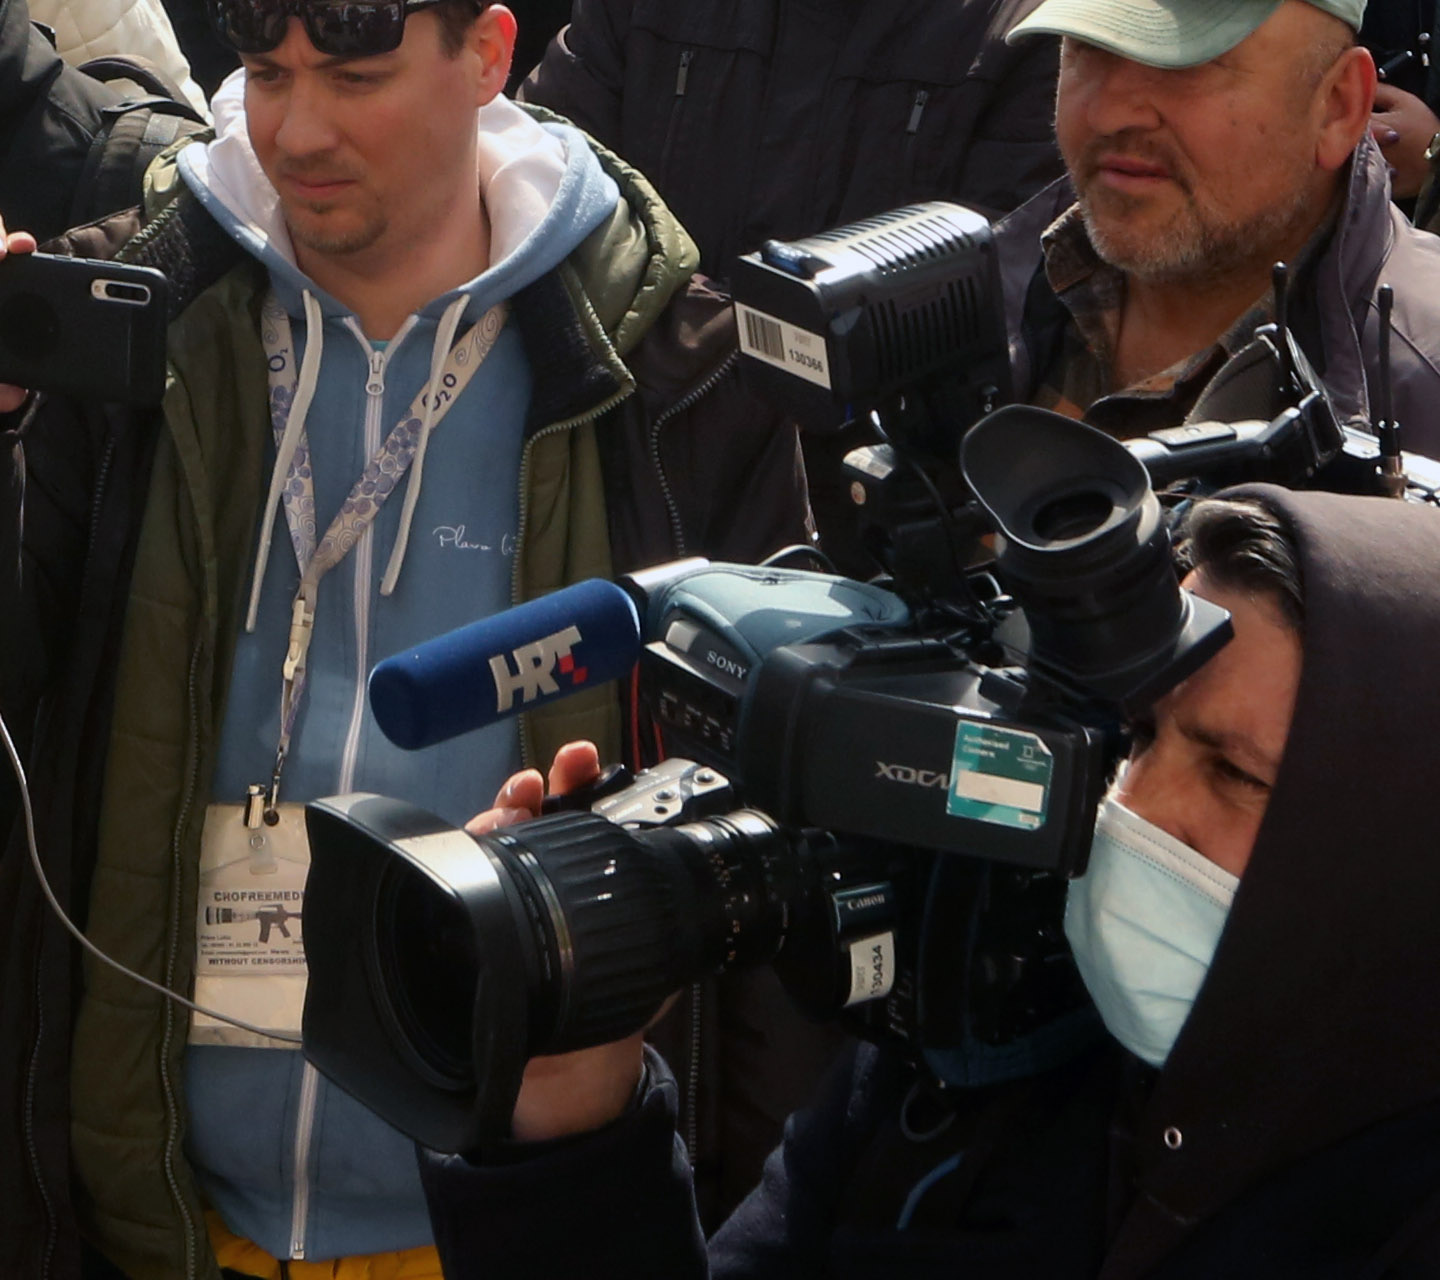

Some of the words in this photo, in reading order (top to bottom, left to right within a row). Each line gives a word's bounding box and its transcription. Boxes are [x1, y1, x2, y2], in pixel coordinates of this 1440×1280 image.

[488, 624, 583, 714] HRT
[705, 649, 748, 680] SONY
[873, 760, 950, 791] XDCA
[847, 892, 887, 911] Canon
[208, 957, 249, 966] WITHOUT
